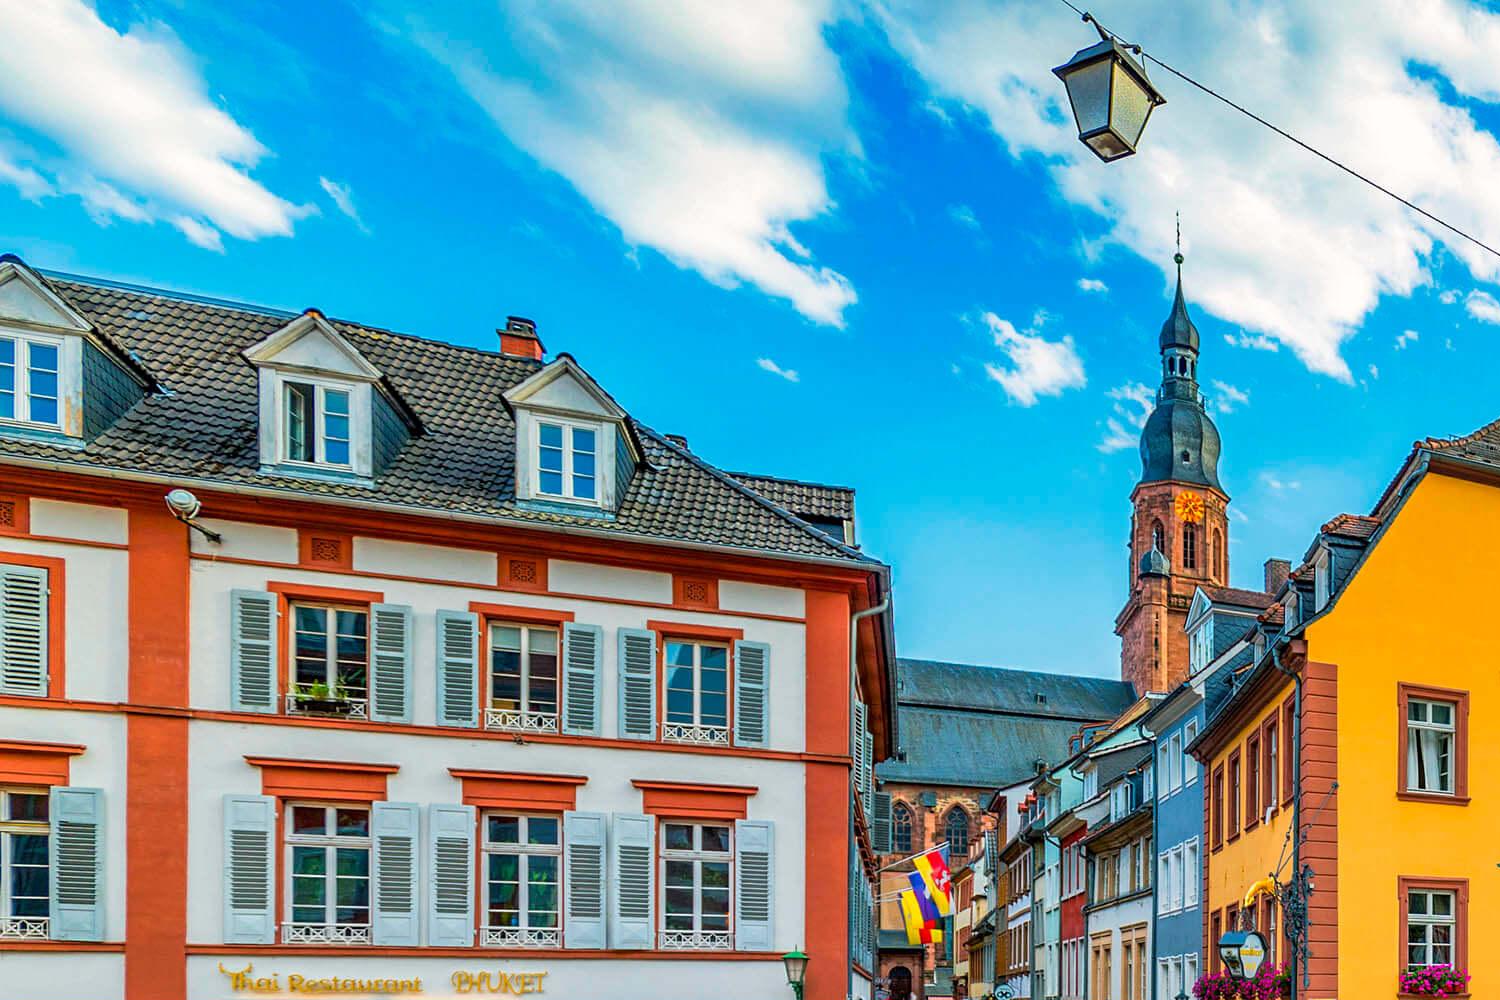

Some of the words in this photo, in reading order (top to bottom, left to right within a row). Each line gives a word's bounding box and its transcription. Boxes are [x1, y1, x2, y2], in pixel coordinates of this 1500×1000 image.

[219, 962, 281, 992] Thai
[288, 973, 424, 993] Restaurant
[451, 970, 549, 996] PHUKET
